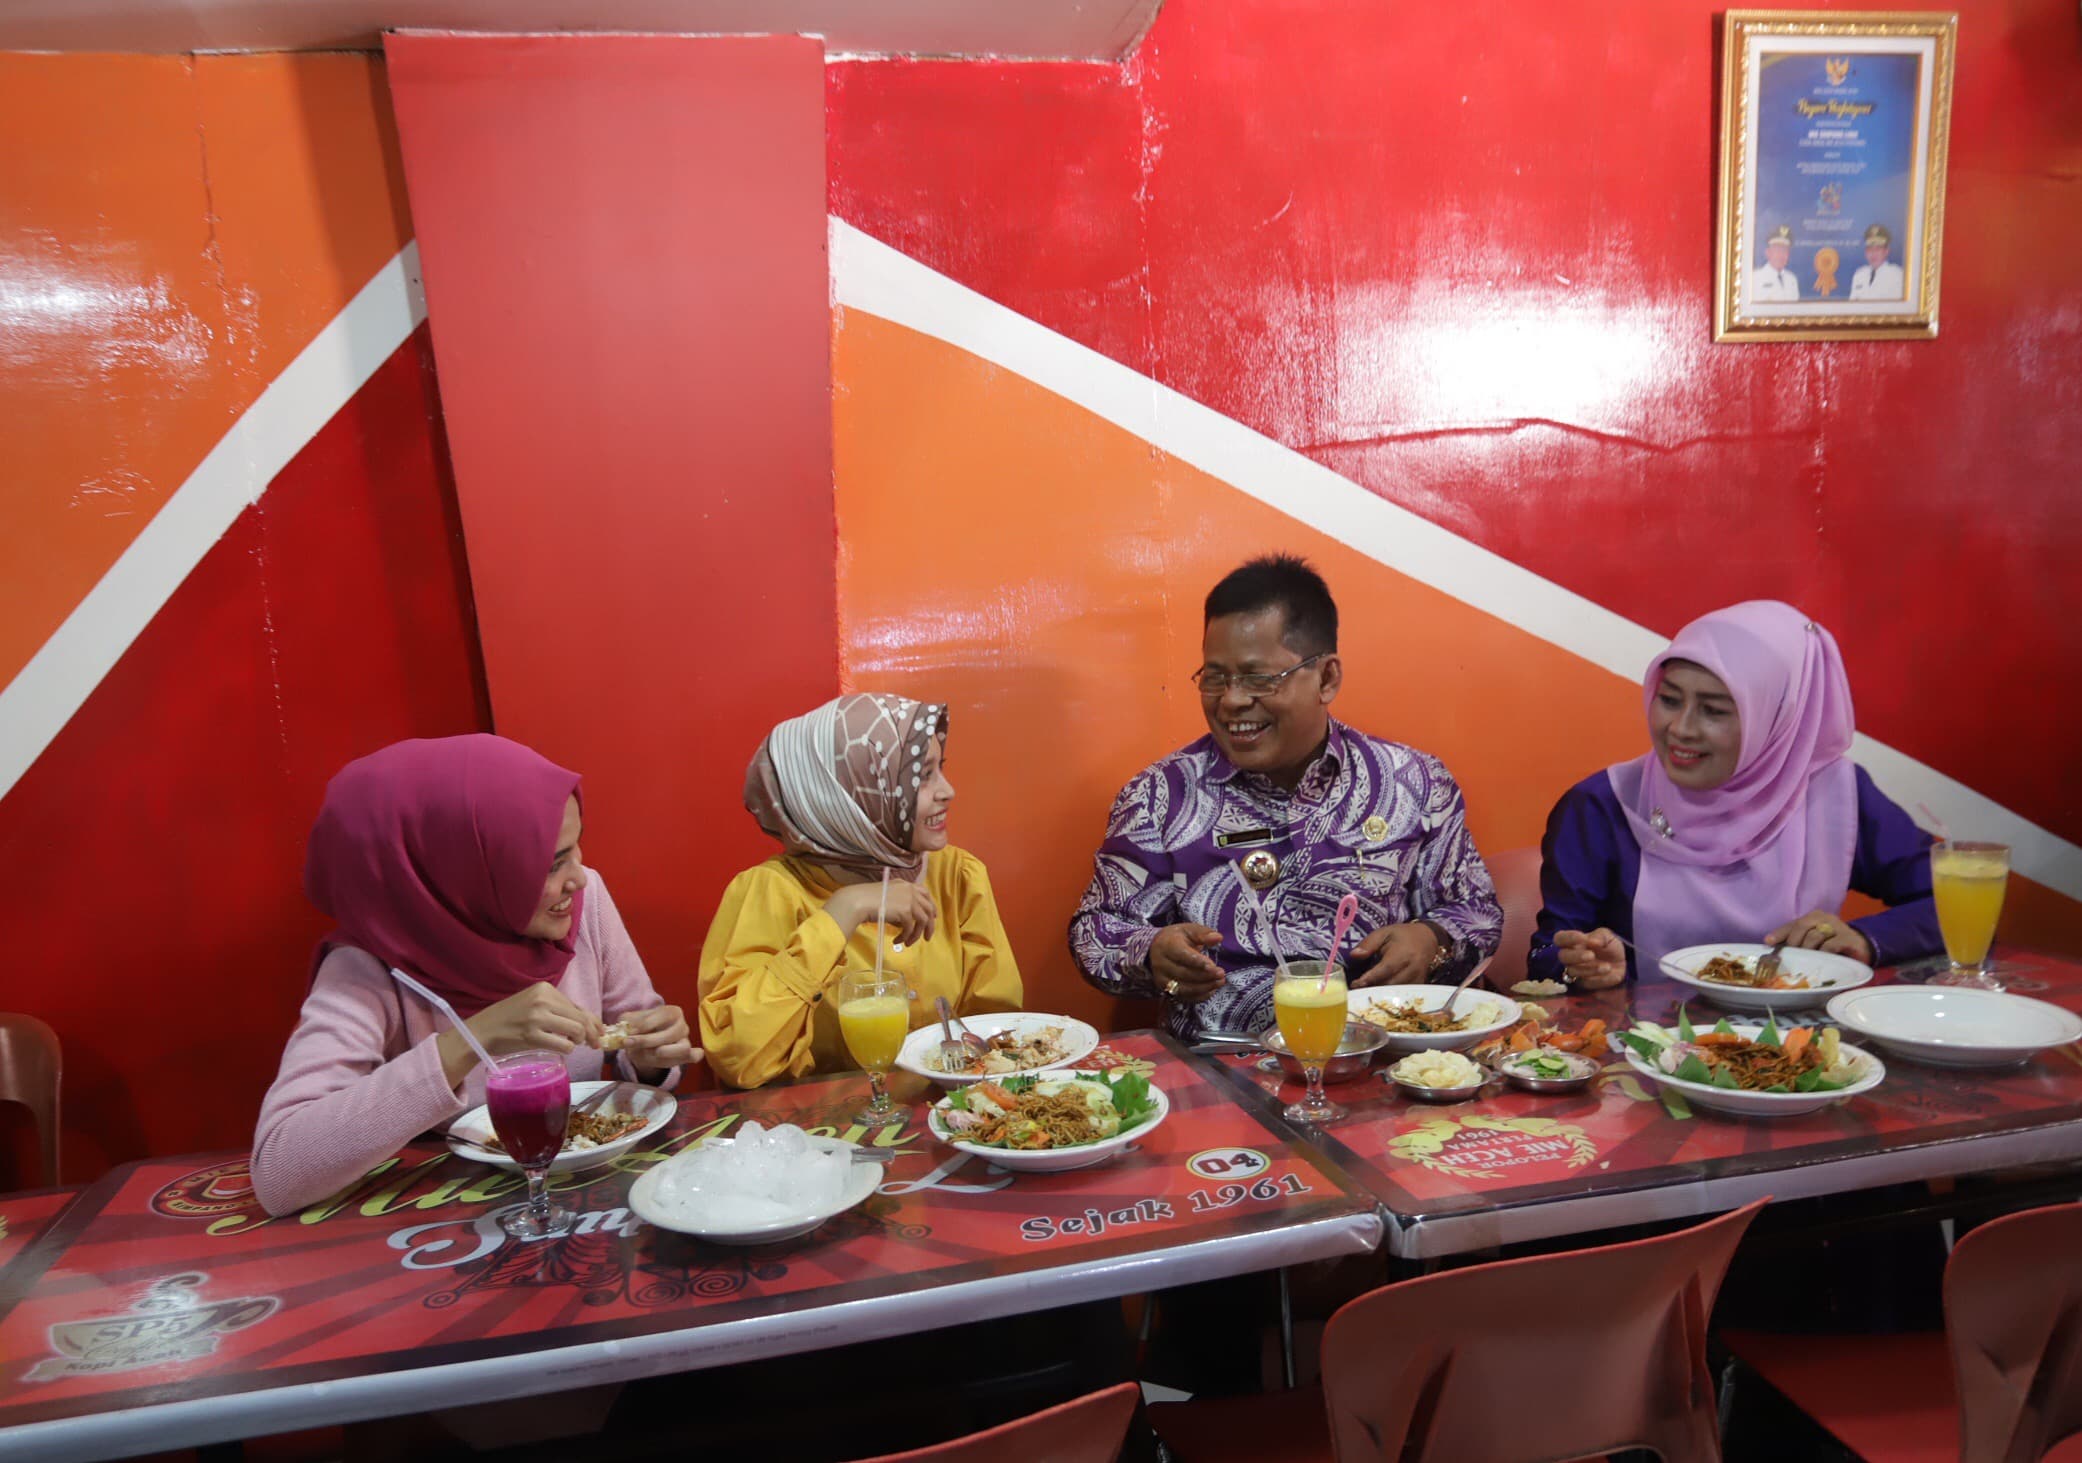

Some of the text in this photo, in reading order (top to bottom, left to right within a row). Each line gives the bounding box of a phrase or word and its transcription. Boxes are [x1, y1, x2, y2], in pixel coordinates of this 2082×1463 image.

[1445, 1134, 1534, 1150] PERTAMA
[1456, 1128, 1499, 1141] 1961
[1197, 1152, 1261, 1174] 04
[1440, 1139, 1571, 1166] MIE ACEH
[1479, 1153, 1562, 1169] PELOPOR
[1020, 1172, 1312, 1241] Sejak 1961
[91, 1315, 192, 1344] SP5
